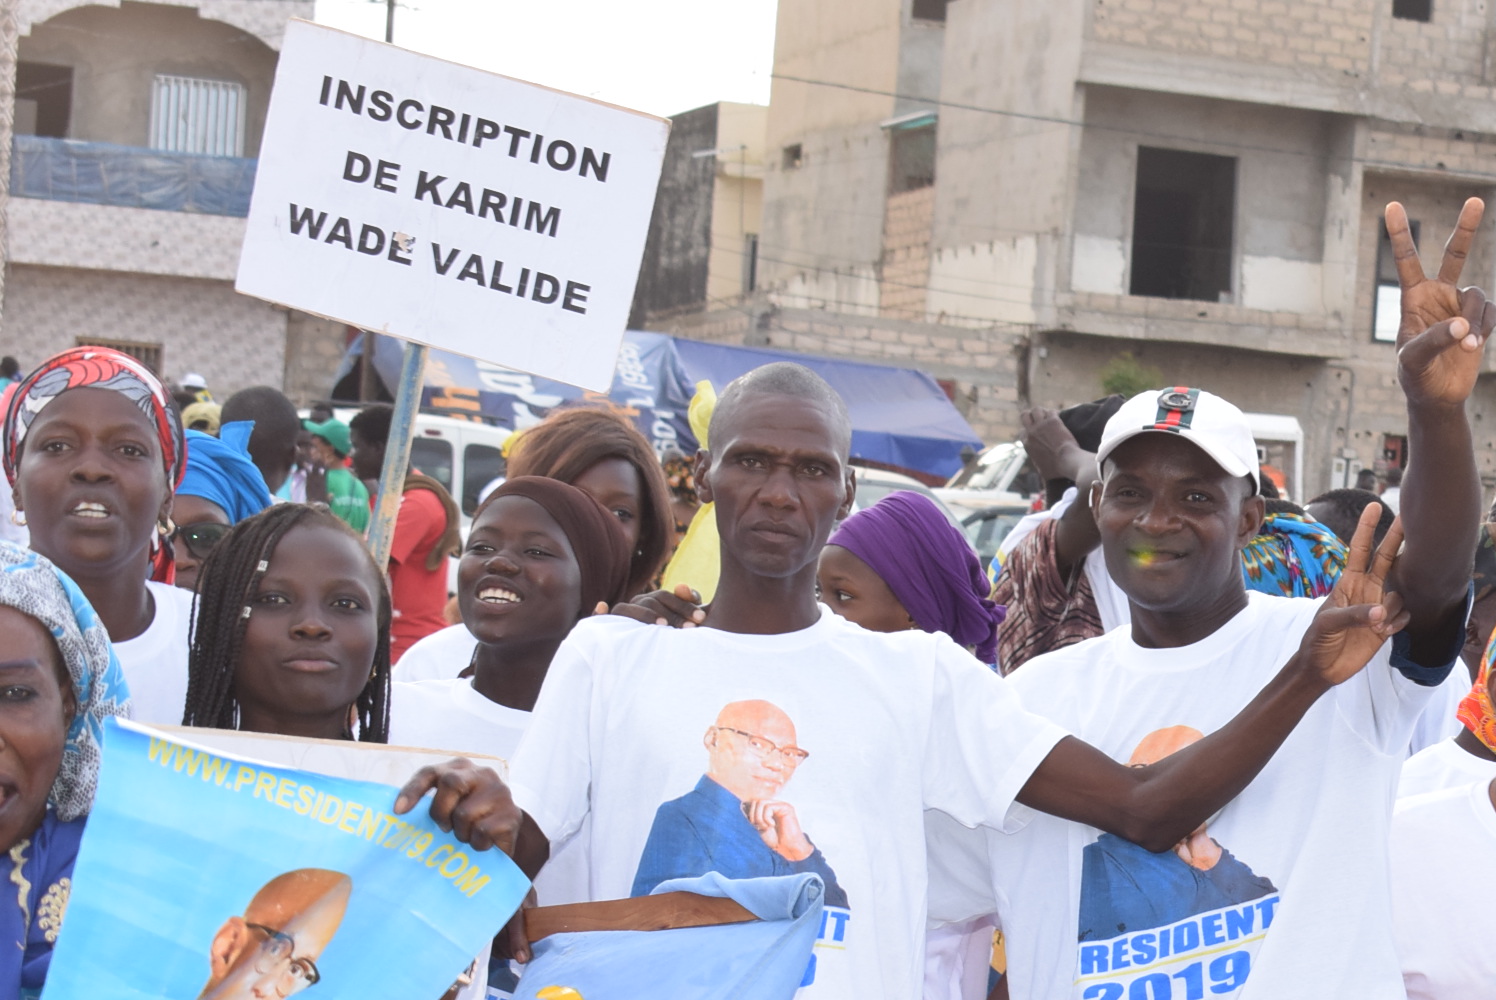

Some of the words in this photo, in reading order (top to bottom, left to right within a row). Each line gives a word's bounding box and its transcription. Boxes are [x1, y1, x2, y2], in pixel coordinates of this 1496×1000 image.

[319, 75, 611, 183] INSCRIPTION
[342, 150, 401, 193] DE
[414, 170, 561, 238] KARIM
[289, 203, 416, 266] WADE
[431, 242, 591, 314] VALIDE
